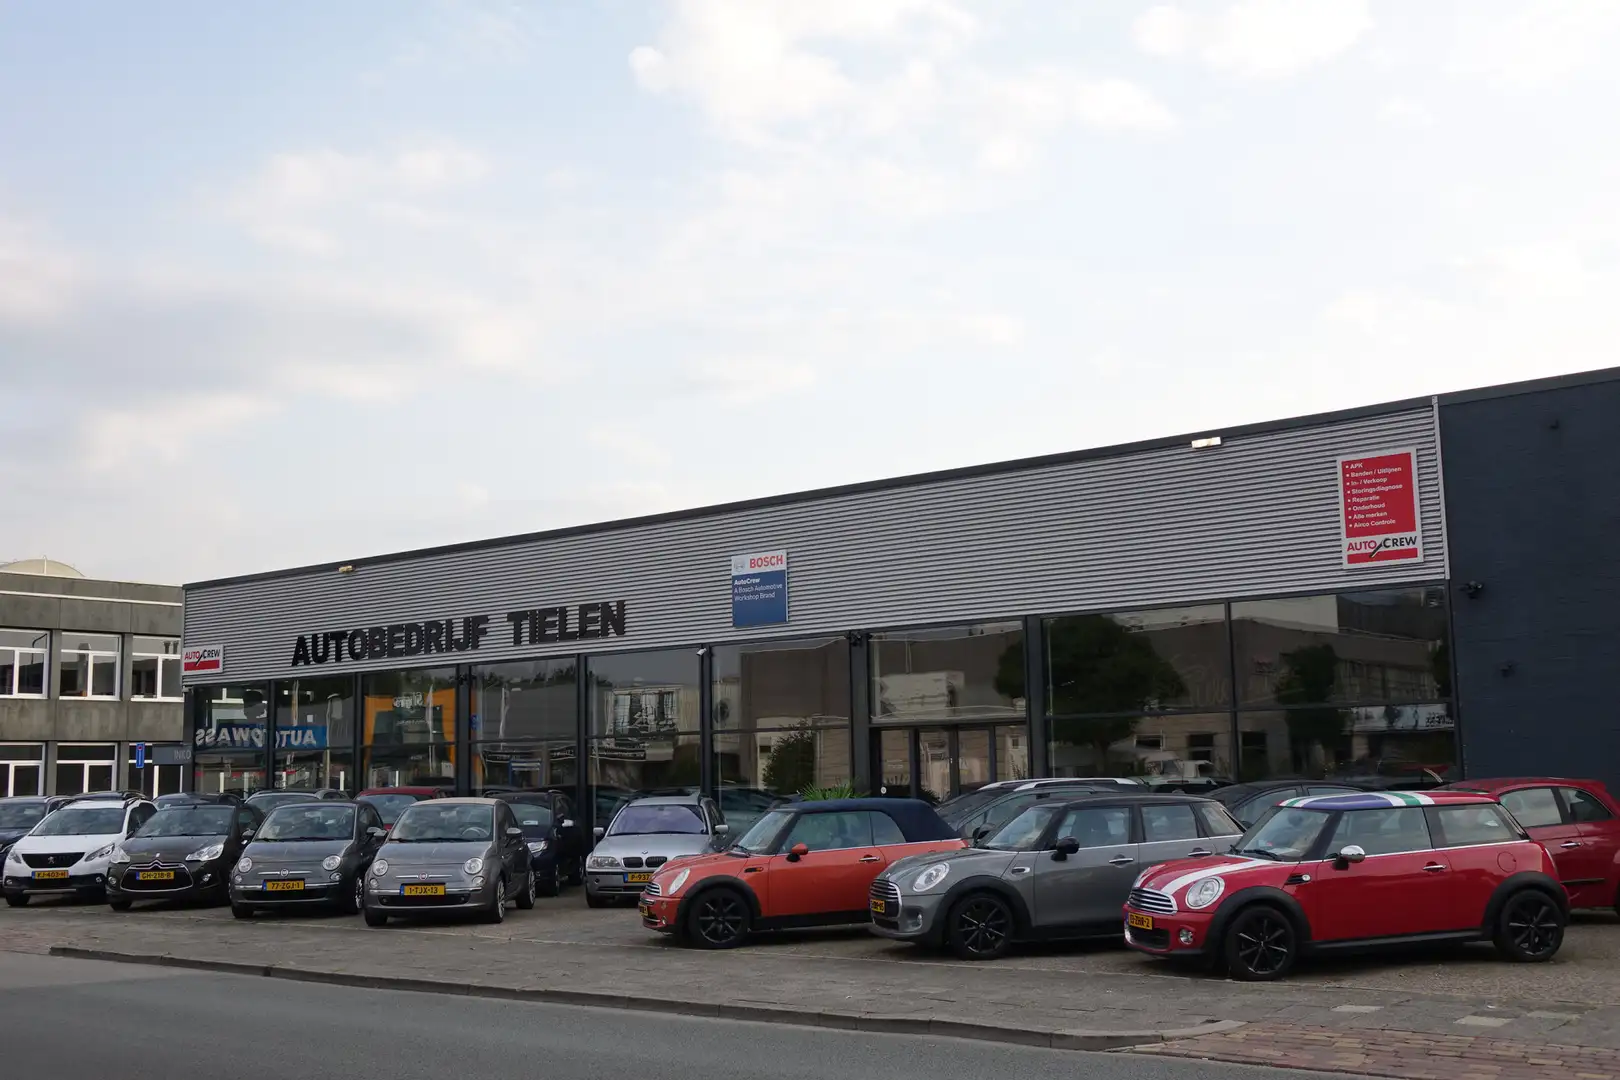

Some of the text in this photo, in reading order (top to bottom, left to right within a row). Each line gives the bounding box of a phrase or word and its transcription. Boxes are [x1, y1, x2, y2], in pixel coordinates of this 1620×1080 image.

[1352, 484, 1403, 494] Storingsdiagnose
[1353, 503, 1385, 511] Onderhoud
[1347, 536, 1417, 551] AUTO CREW
[750, 555, 784, 568] BOSCH
[734, 593, 759, 601] Workshop
[291, 600, 626, 666] AUTOBEDRIJF TIELEN
[184, 649, 220, 660] AUTO CREW
